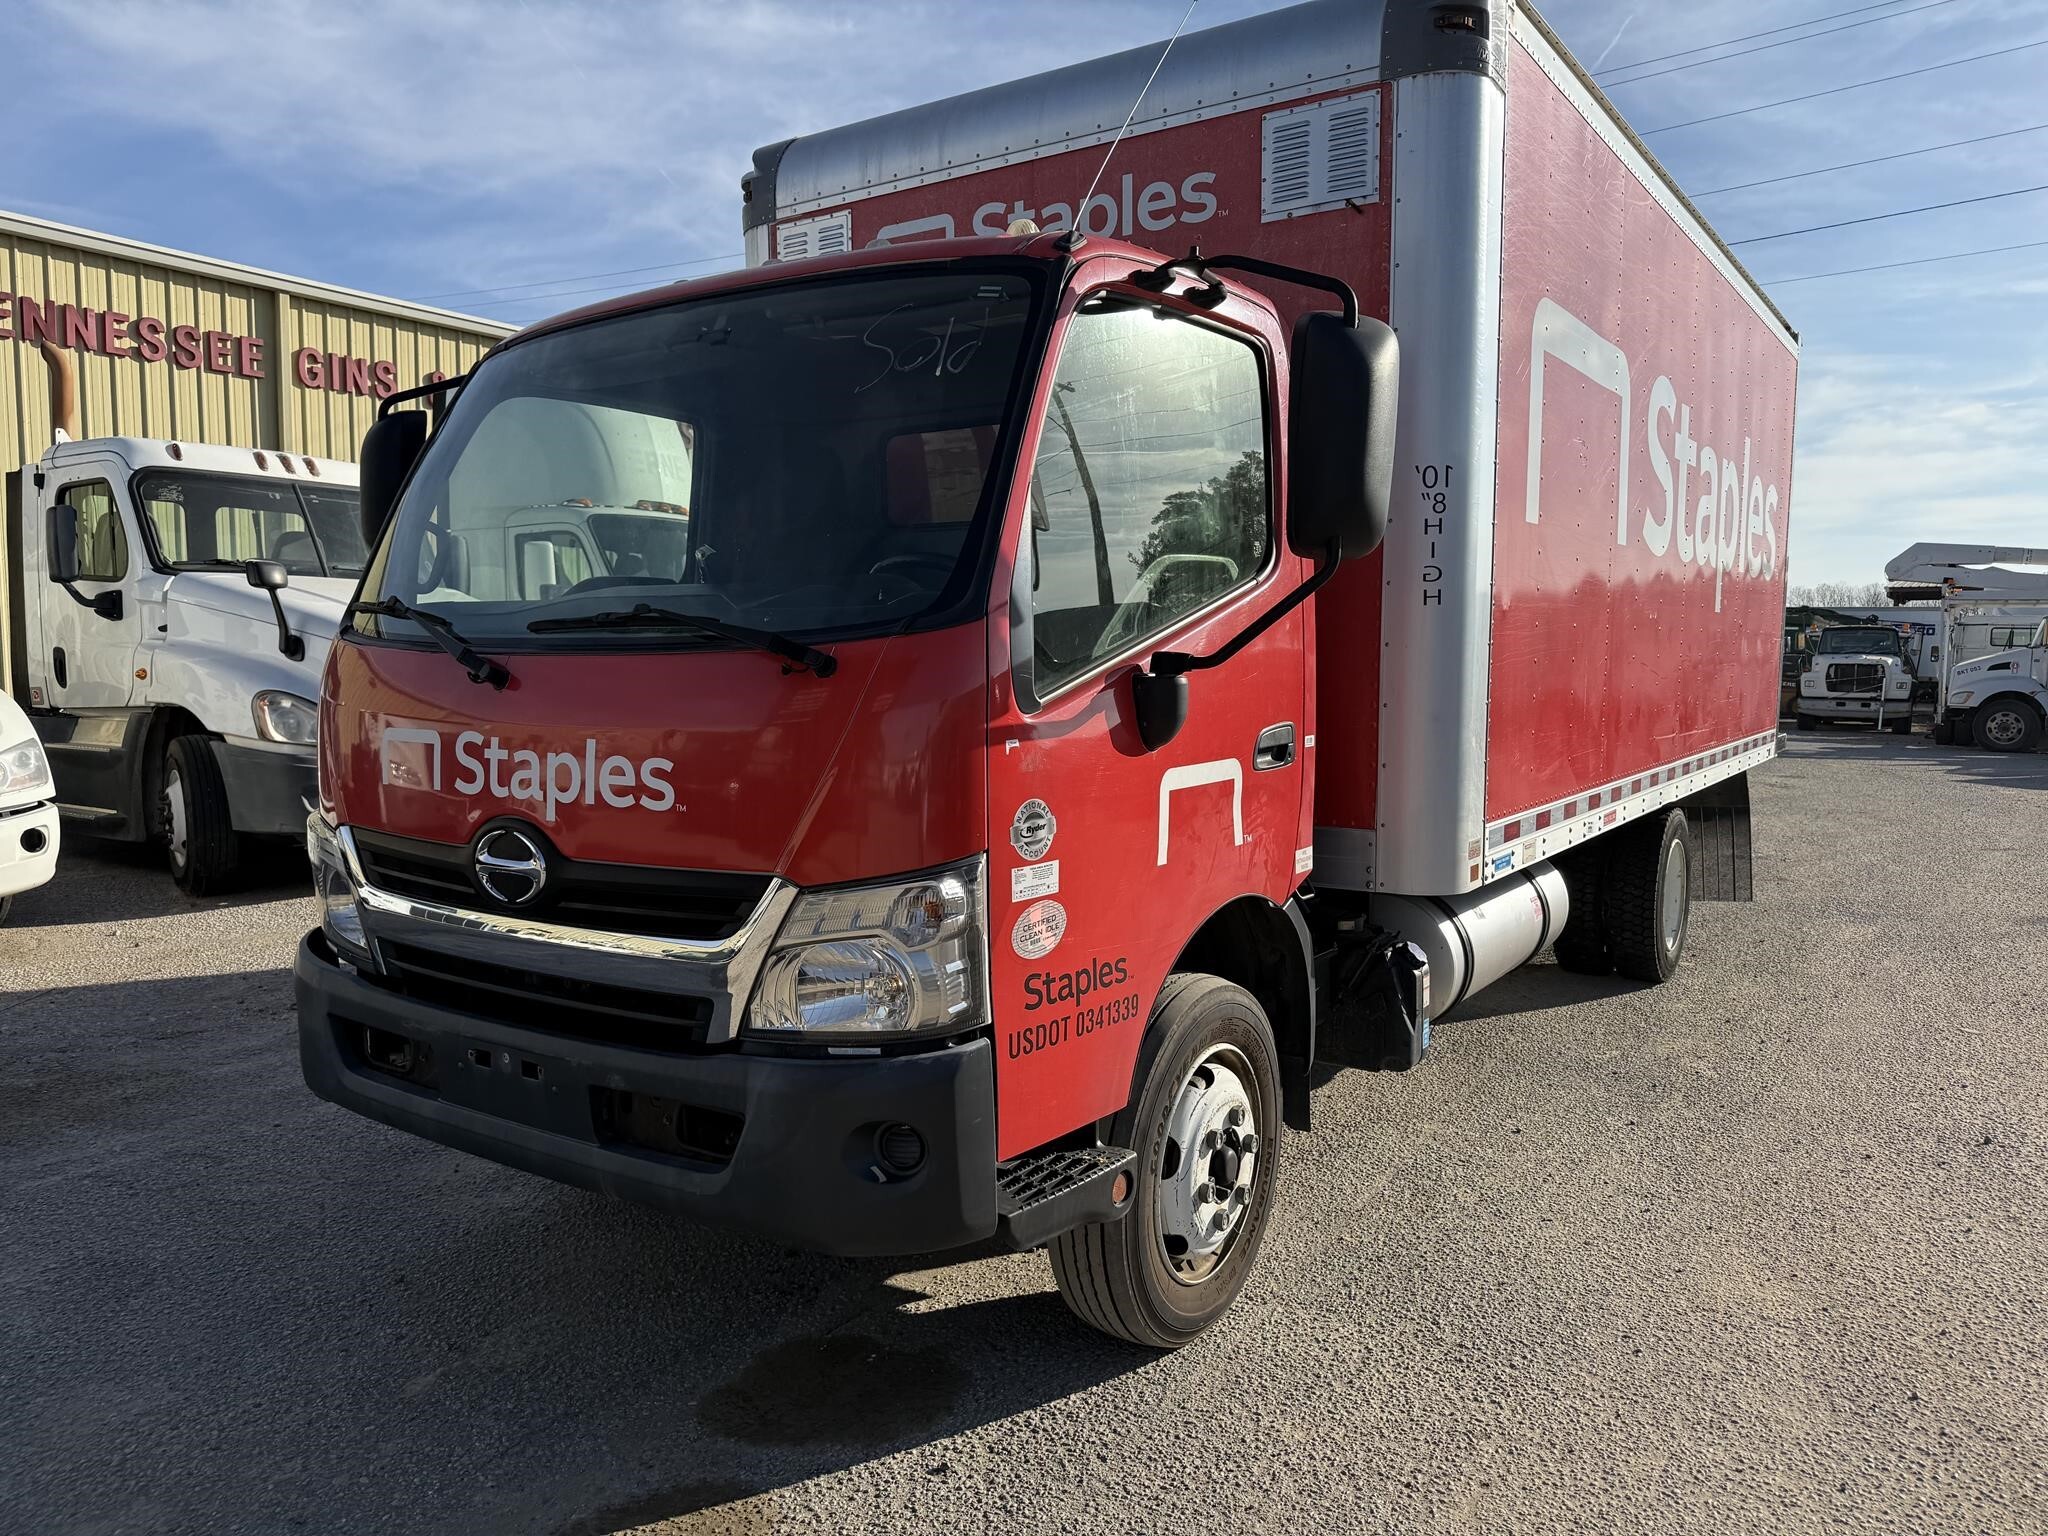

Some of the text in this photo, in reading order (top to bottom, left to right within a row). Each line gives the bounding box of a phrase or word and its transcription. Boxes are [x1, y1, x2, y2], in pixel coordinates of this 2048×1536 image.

[972, 171, 1218, 239] Staples
[297, 346, 399, 400] GINS
[1642, 375, 1778, 613] Staples
[454, 730, 676, 822] Staples
[1016, 801, 1050, 824] NATIONAL
[1021, 823, 1047, 838] Ryder
[1018, 836, 1052, 858] ACCOUNT
[1020, 929, 1043, 943] CLEAN
[1022, 914, 1057, 932] CERTIFIED
[1023, 957, 1128, 1011] Staples
[1008, 993, 1139, 1060] USDOT 0341339
